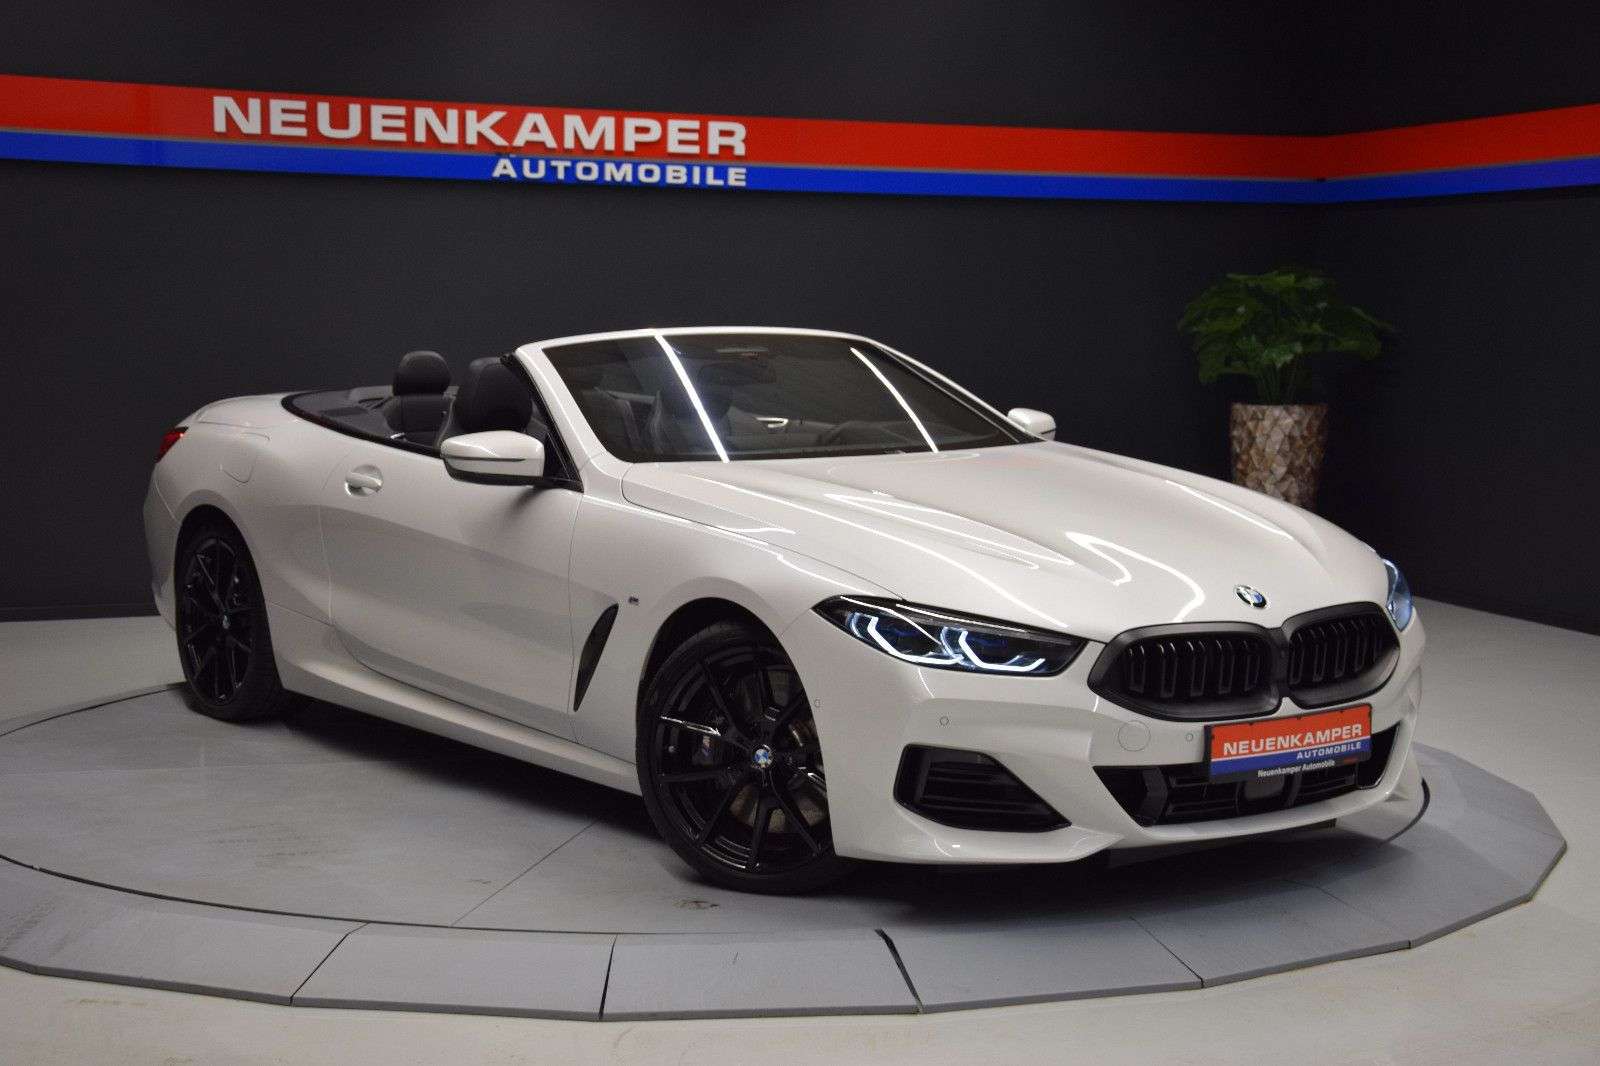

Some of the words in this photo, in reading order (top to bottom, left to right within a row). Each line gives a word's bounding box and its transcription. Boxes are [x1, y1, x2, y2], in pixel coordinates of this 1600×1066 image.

[212, 96, 747, 156] NEUENKAMPER
[492, 157, 747, 187] AUTOMOBILE
[1223, 724, 1362, 755] NEUENKAMPER
[1297, 742, 1361, 759] AUTOMOBILE
[1258, 765, 1301, 777] Neuenkamper
[1302, 760, 1335, 772] Automobile
